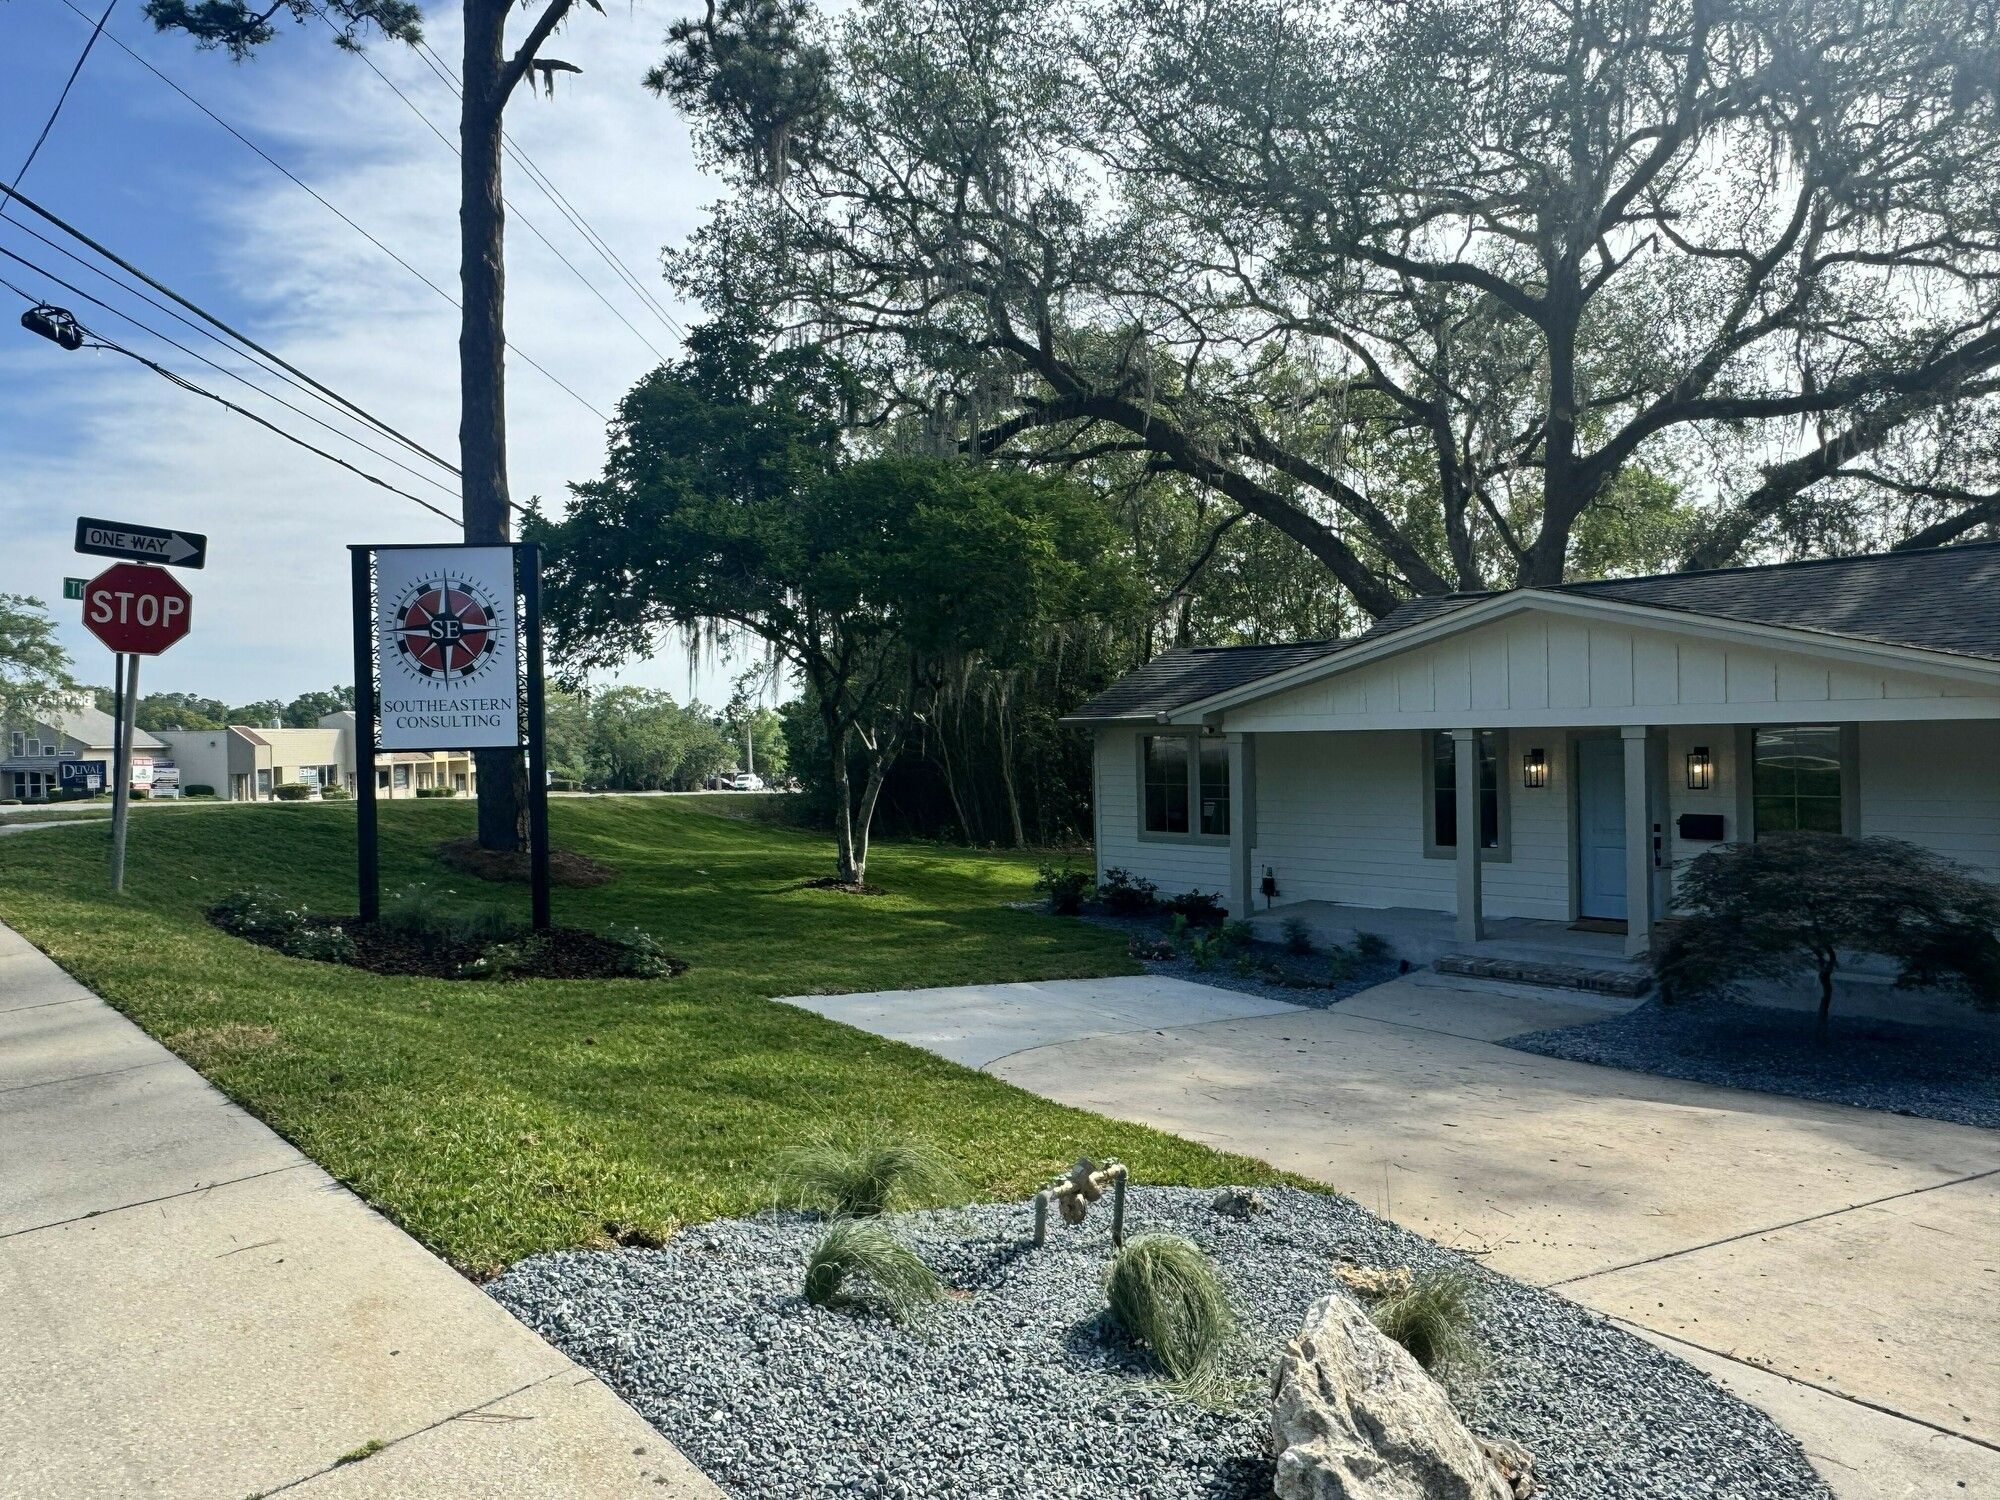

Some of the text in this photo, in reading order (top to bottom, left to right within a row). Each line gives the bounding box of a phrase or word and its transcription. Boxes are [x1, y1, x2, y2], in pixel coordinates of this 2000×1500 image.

[91, 530, 168, 553] ONE WAY
[90, 590, 185, 628] STOP
[430, 620, 461, 639] SE
[384, 698, 512, 713] SOUTHEASTERN
[396, 714, 501, 729] CONSULTING
